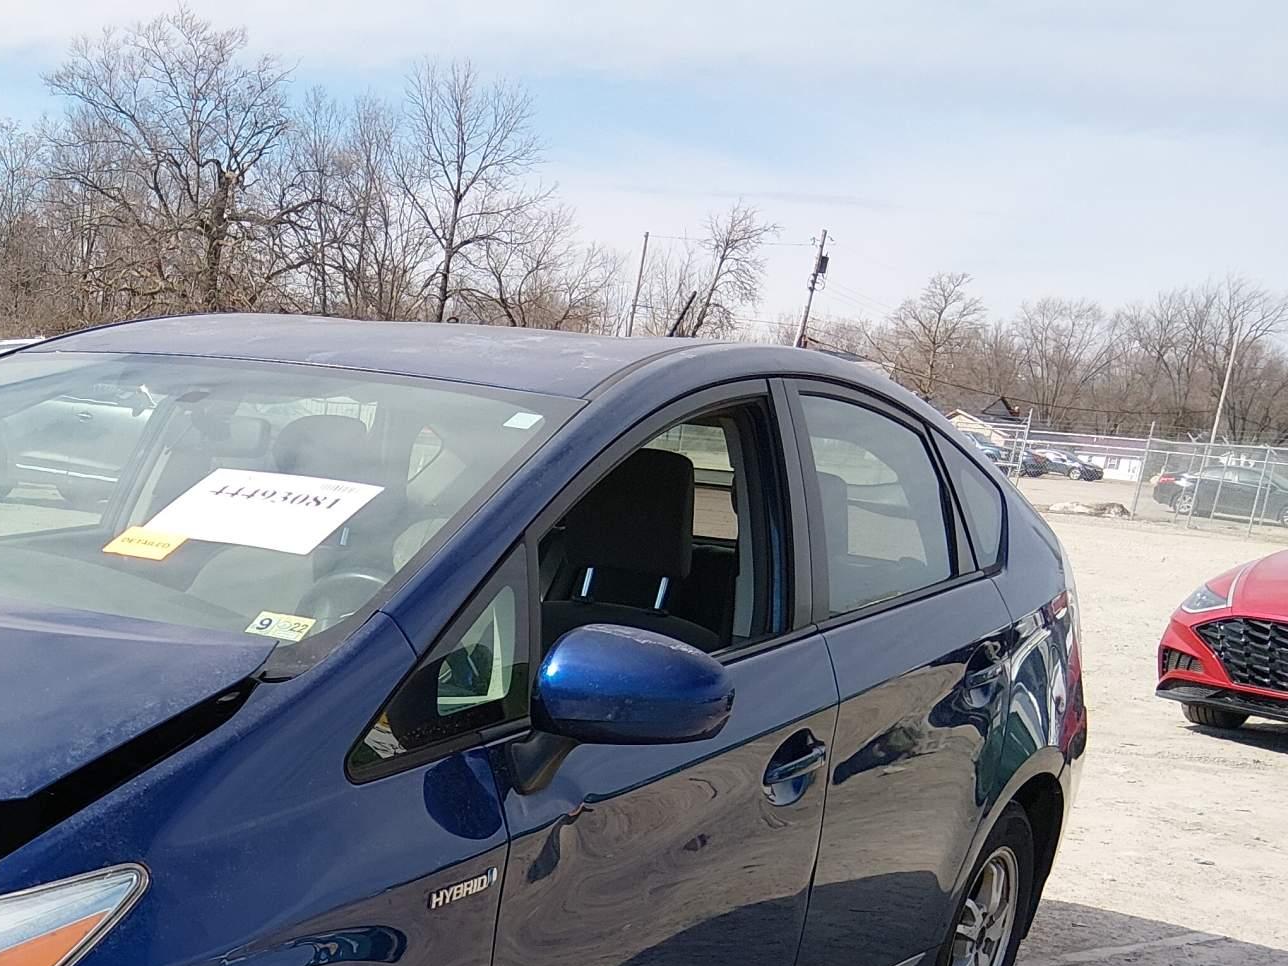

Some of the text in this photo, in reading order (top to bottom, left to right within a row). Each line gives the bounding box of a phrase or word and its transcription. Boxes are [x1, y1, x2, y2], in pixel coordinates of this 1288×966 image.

[209, 485, 341, 509] 44493081
[255, 617, 309, 634] 9 22
[430, 874, 489, 910] HYBRID
